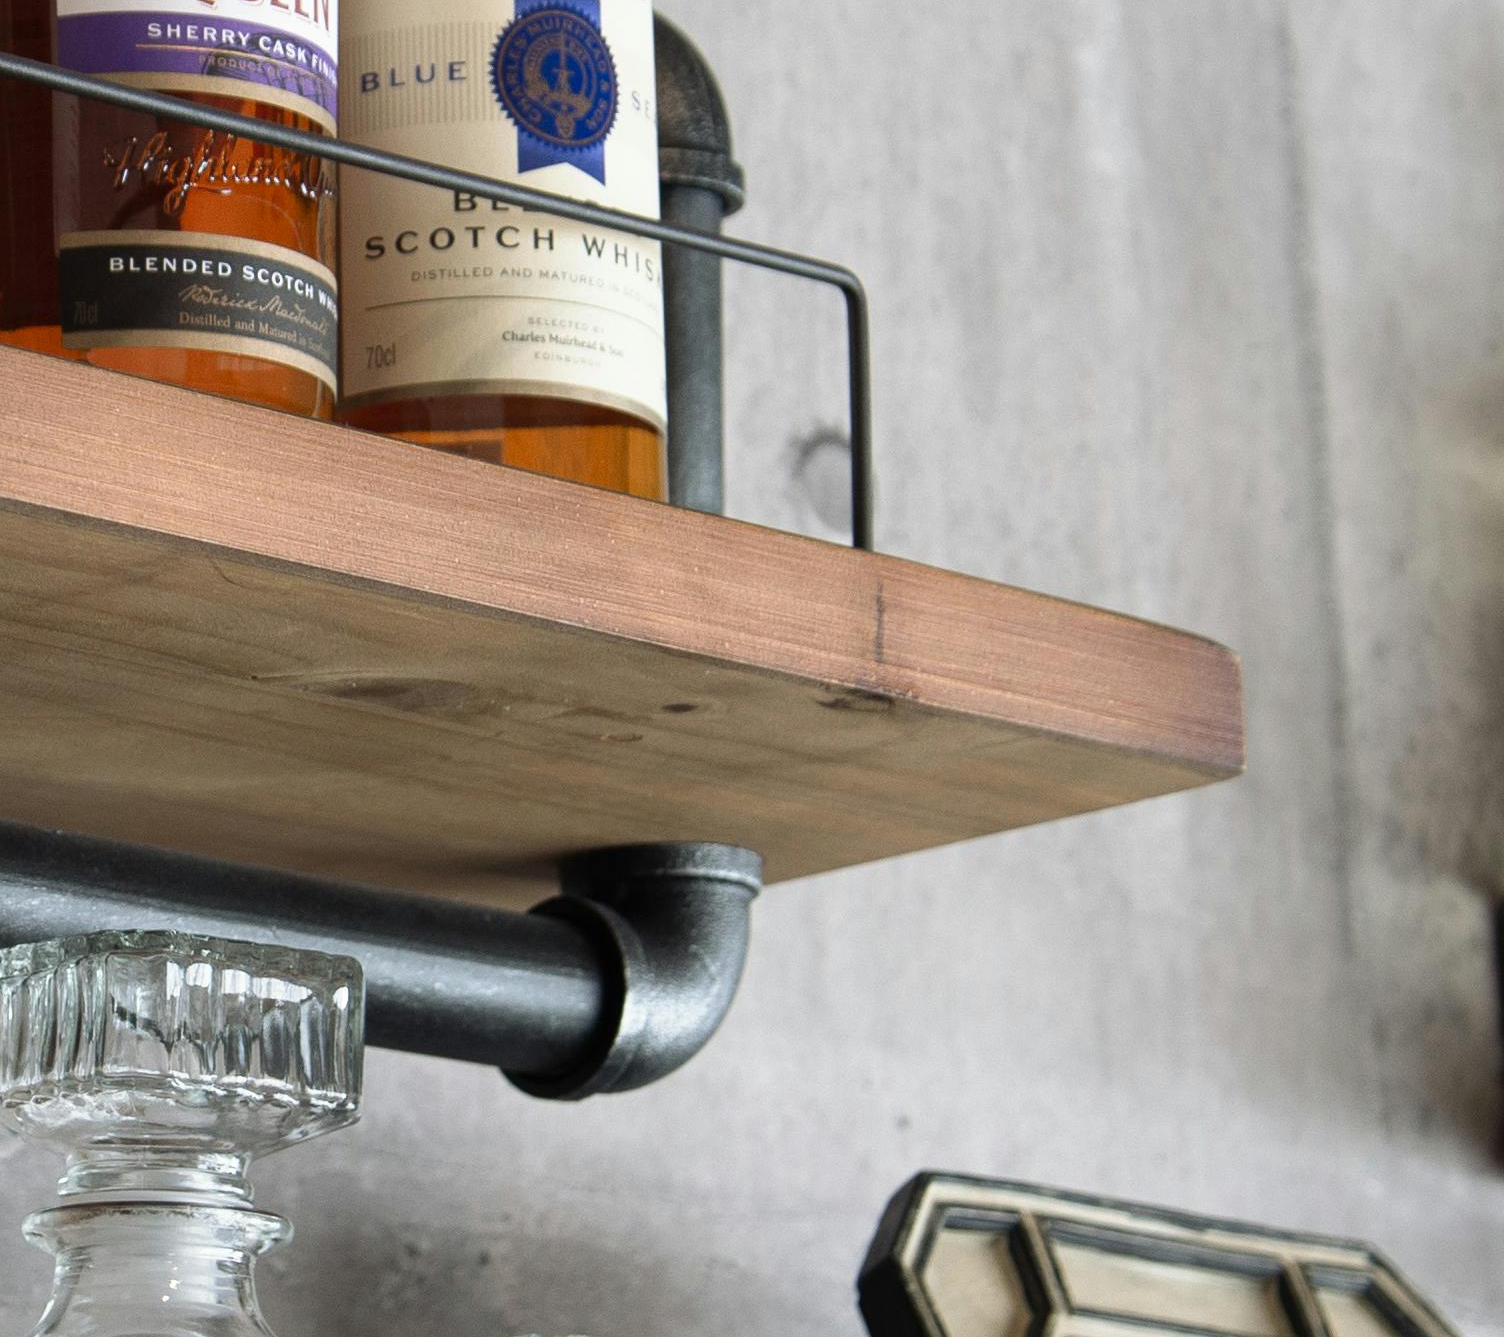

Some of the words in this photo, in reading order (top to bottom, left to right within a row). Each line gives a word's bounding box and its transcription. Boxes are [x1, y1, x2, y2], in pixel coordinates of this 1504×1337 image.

[147, 22, 250, 47] SHERRY
[258, 35, 308, 63] CASK
[359, 59, 467, 94] BLUE
[364, 226, 555, 260] SCOTCH
[109, 256, 232, 278] BLENDED
[242, 265, 314, 300] SCOTCH
[411, 267, 493, 282] DISTILLED
[500, 267, 533, 279] AND
[539, 269, 605, 289] MATURED
[179, 312, 231, 328] Distilled
[235, 319, 255, 332] and
[259, 323, 297, 343] Matured
[501, 330, 546, 344] Charles
[549, 333, 598, 351] Muirhead
[365, 344, 396, 369] 70cl
